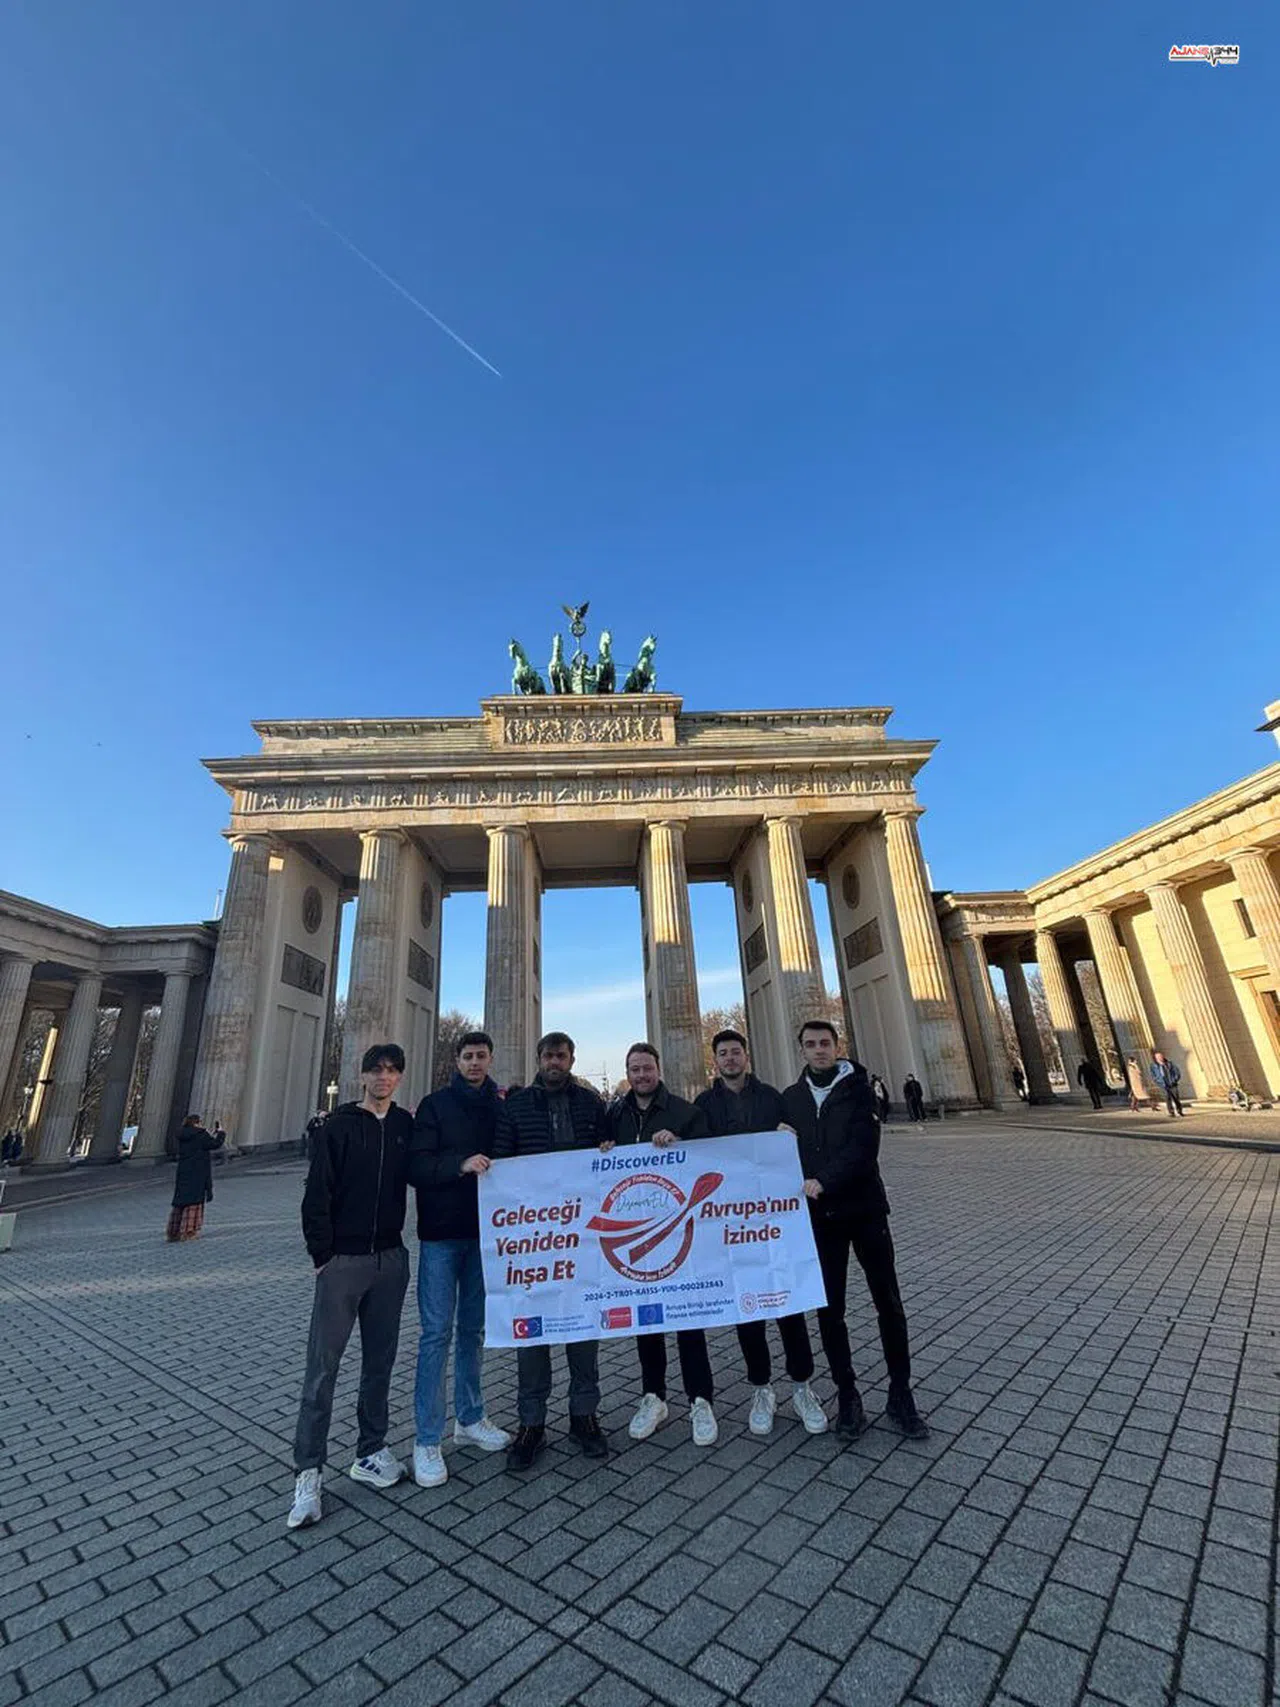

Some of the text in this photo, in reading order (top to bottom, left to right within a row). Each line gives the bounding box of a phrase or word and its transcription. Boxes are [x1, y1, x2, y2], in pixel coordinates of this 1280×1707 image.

[591, 1150, 687, 1172] #DiscoverEU
[491, 1197, 582, 1228] Geleceği
[699, 1196, 800, 1220] Avrupa'nın
[495, 1230, 580, 1257] Yeniden
[724, 1223, 781, 1245] İzinde
[506, 1259, 575, 1290] İnşa Et
